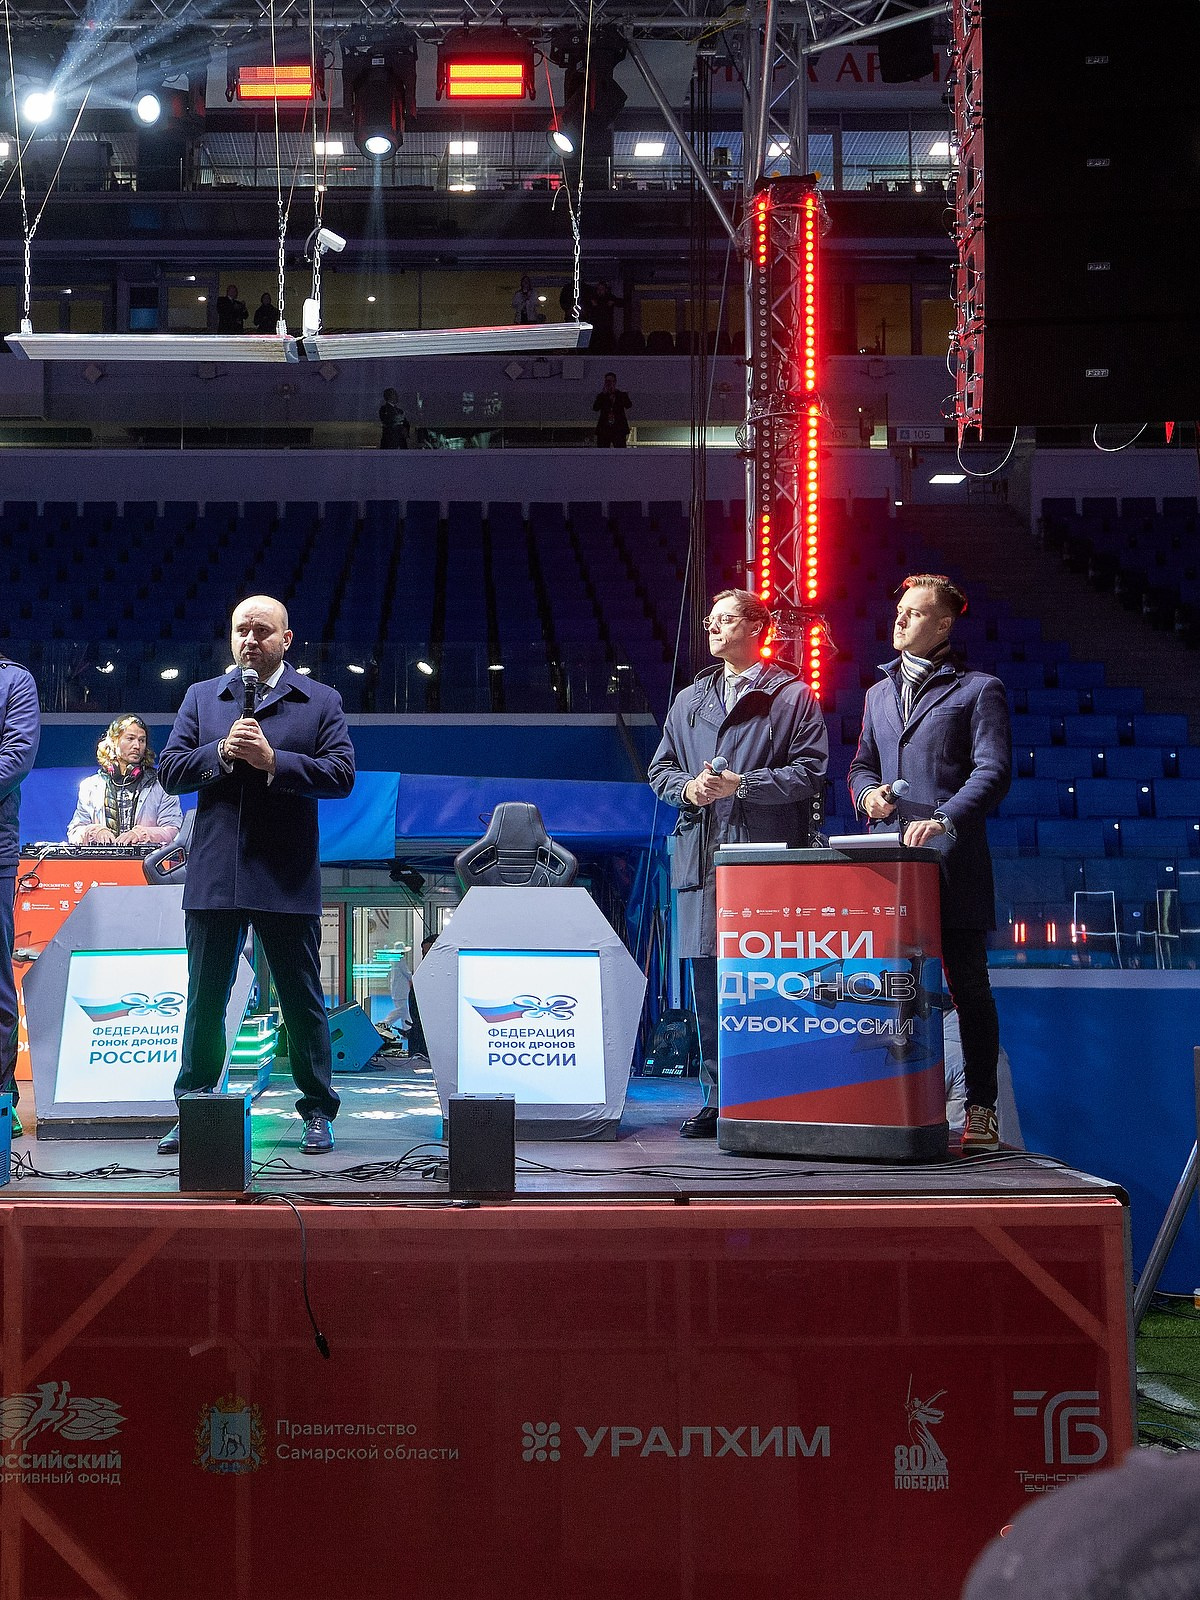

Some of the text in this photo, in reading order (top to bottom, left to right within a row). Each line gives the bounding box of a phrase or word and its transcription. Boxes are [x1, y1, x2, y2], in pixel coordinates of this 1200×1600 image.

[718, 930, 874, 959] ГОНКИ
[719, 971, 917, 1005] ДРОНОВ
[92, 1024, 179, 1037] ФЕДЕРАЦИЯ
[488, 1027, 575, 1039] ФЕДЕРАЦИЯ
[719, 1015, 914, 1035] КУБОК РОССИИ
[91, 1037, 178, 1047] ГОНОК ДРОНОВ
[488, 1041, 576, 1050] ГОНОК ДРОНОВ
[89, 1049, 177, 1065] РОССИИ
[488, 1053, 577, 1067] РОССИИ
[275, 1419, 418, 1438] Правительство
[574, 1426, 832, 1458] УРАЛХИМ
[275, 1442, 460, 1463] Самарской области
[893, 1444, 926, 1472] 80
[77, 1472, 122, 1487] ФОНД
[894, 1474, 950, 1493] ПОБЕДА!
